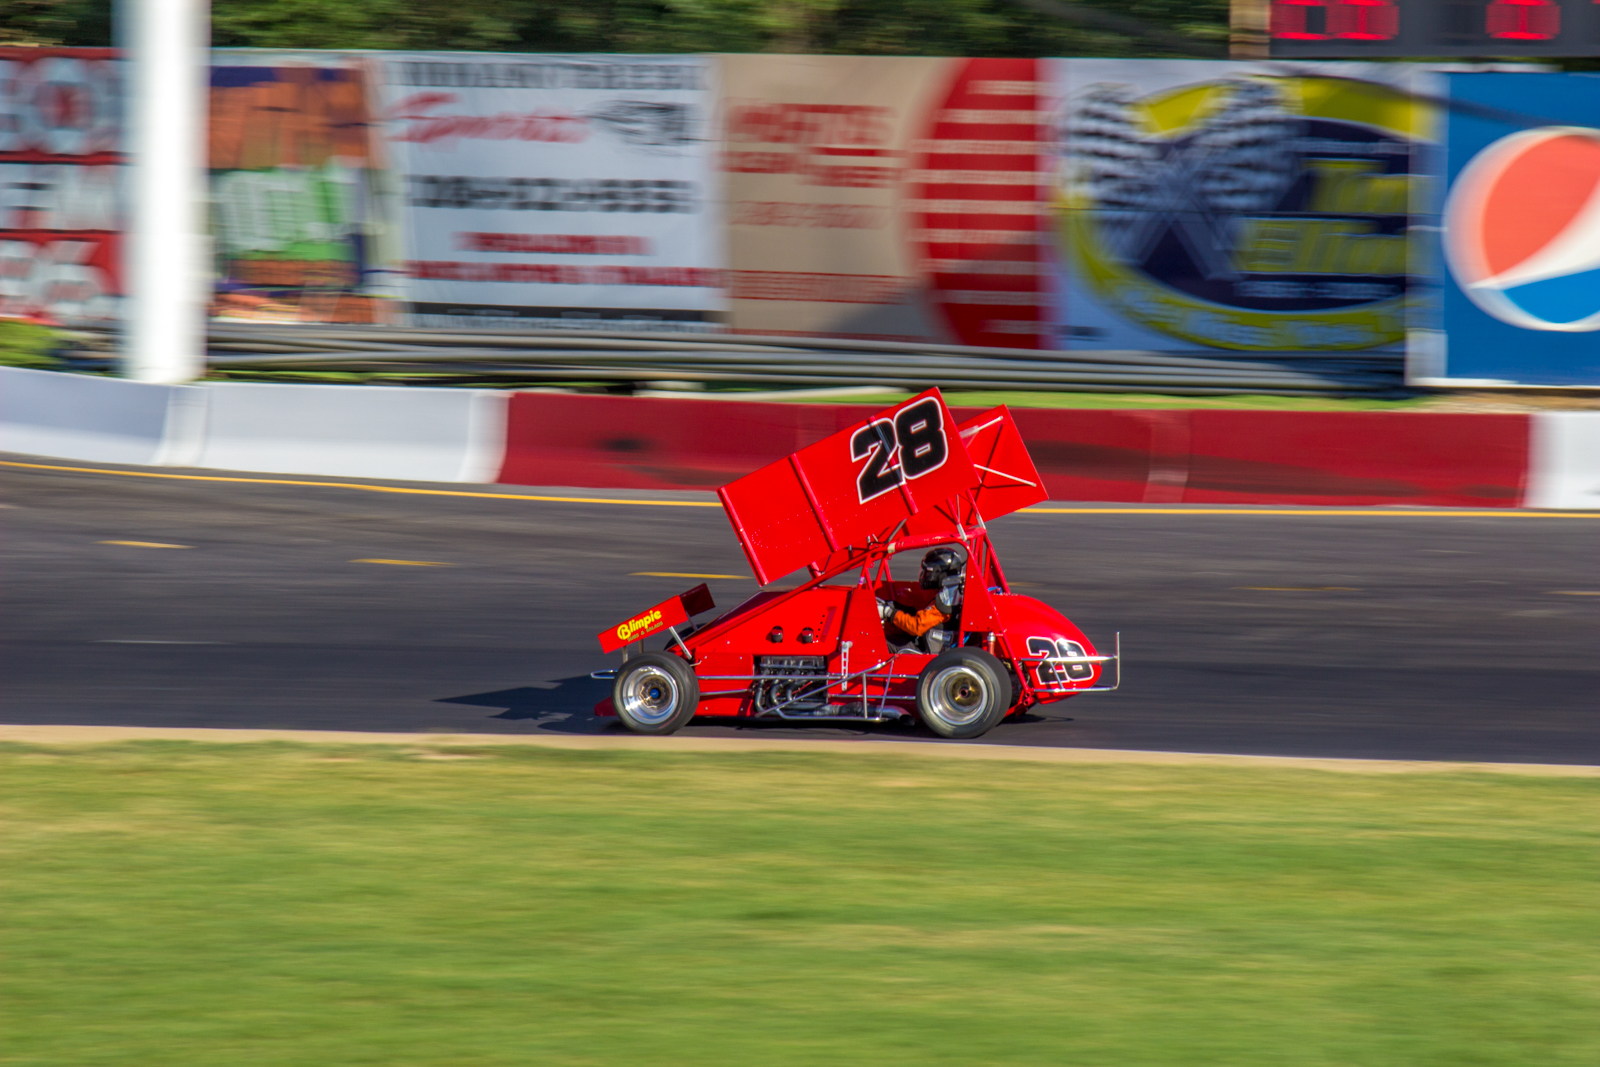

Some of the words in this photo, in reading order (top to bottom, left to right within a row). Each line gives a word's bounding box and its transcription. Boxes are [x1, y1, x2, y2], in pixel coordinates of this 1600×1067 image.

[850, 396, 949, 505] 28
[617, 610, 662, 640] Blimpie
[1026, 636, 1094, 685] 28
